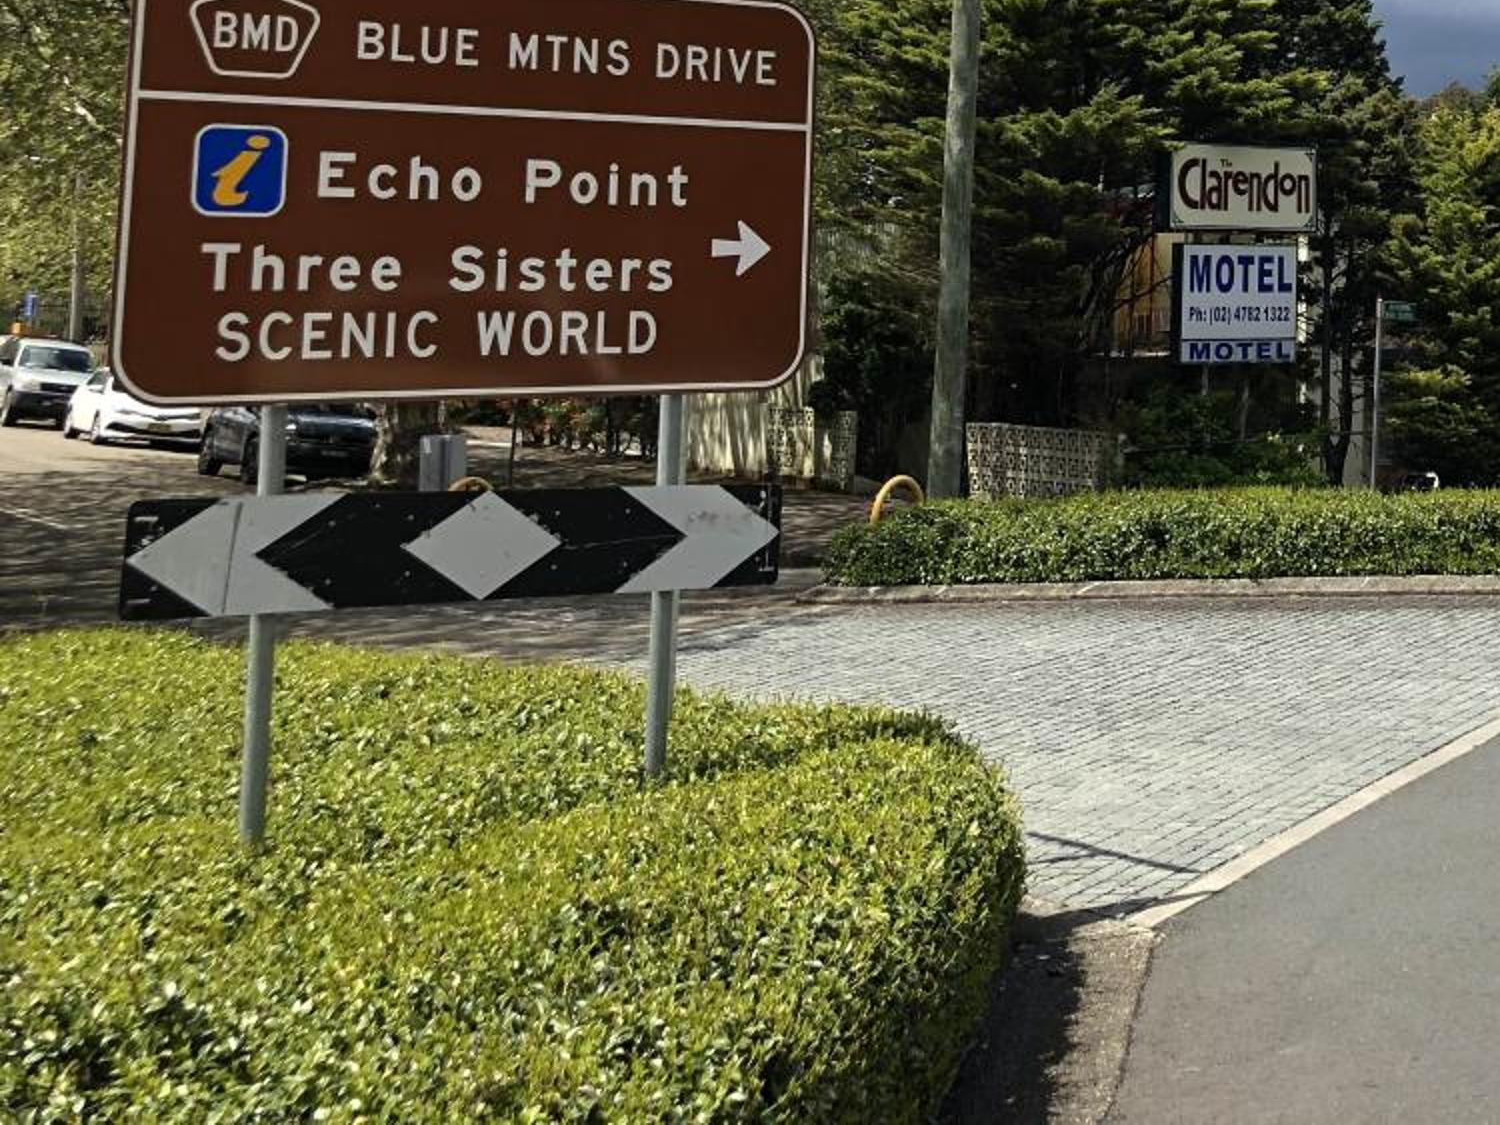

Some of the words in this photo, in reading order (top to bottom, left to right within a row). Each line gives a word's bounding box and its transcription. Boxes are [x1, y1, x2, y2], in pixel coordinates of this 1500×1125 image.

[211, 11, 300, 53] BMD
[357, 22, 478, 66] BLUE
[509, 33, 630, 76] MTNS
[656, 44, 776, 85] DRIVE
[317, 152, 482, 202] Echo
[525, 159, 689, 207] Point
[1178, 158, 1310, 213] Clarendon
[201, 243, 401, 292] Three
[449, 245, 673, 292] Sisters
[1189, 255, 1292, 293] MOTEL
[215, 310, 439, 362] SCENIC
[477, 310, 657, 356] WORLD
[1189, 307, 1206, 322] Ph:
[1210, 306, 1230, 325] (02)
[1263, 306, 1290, 322] 1322
[1189, 342, 1290, 360] MOTEL
